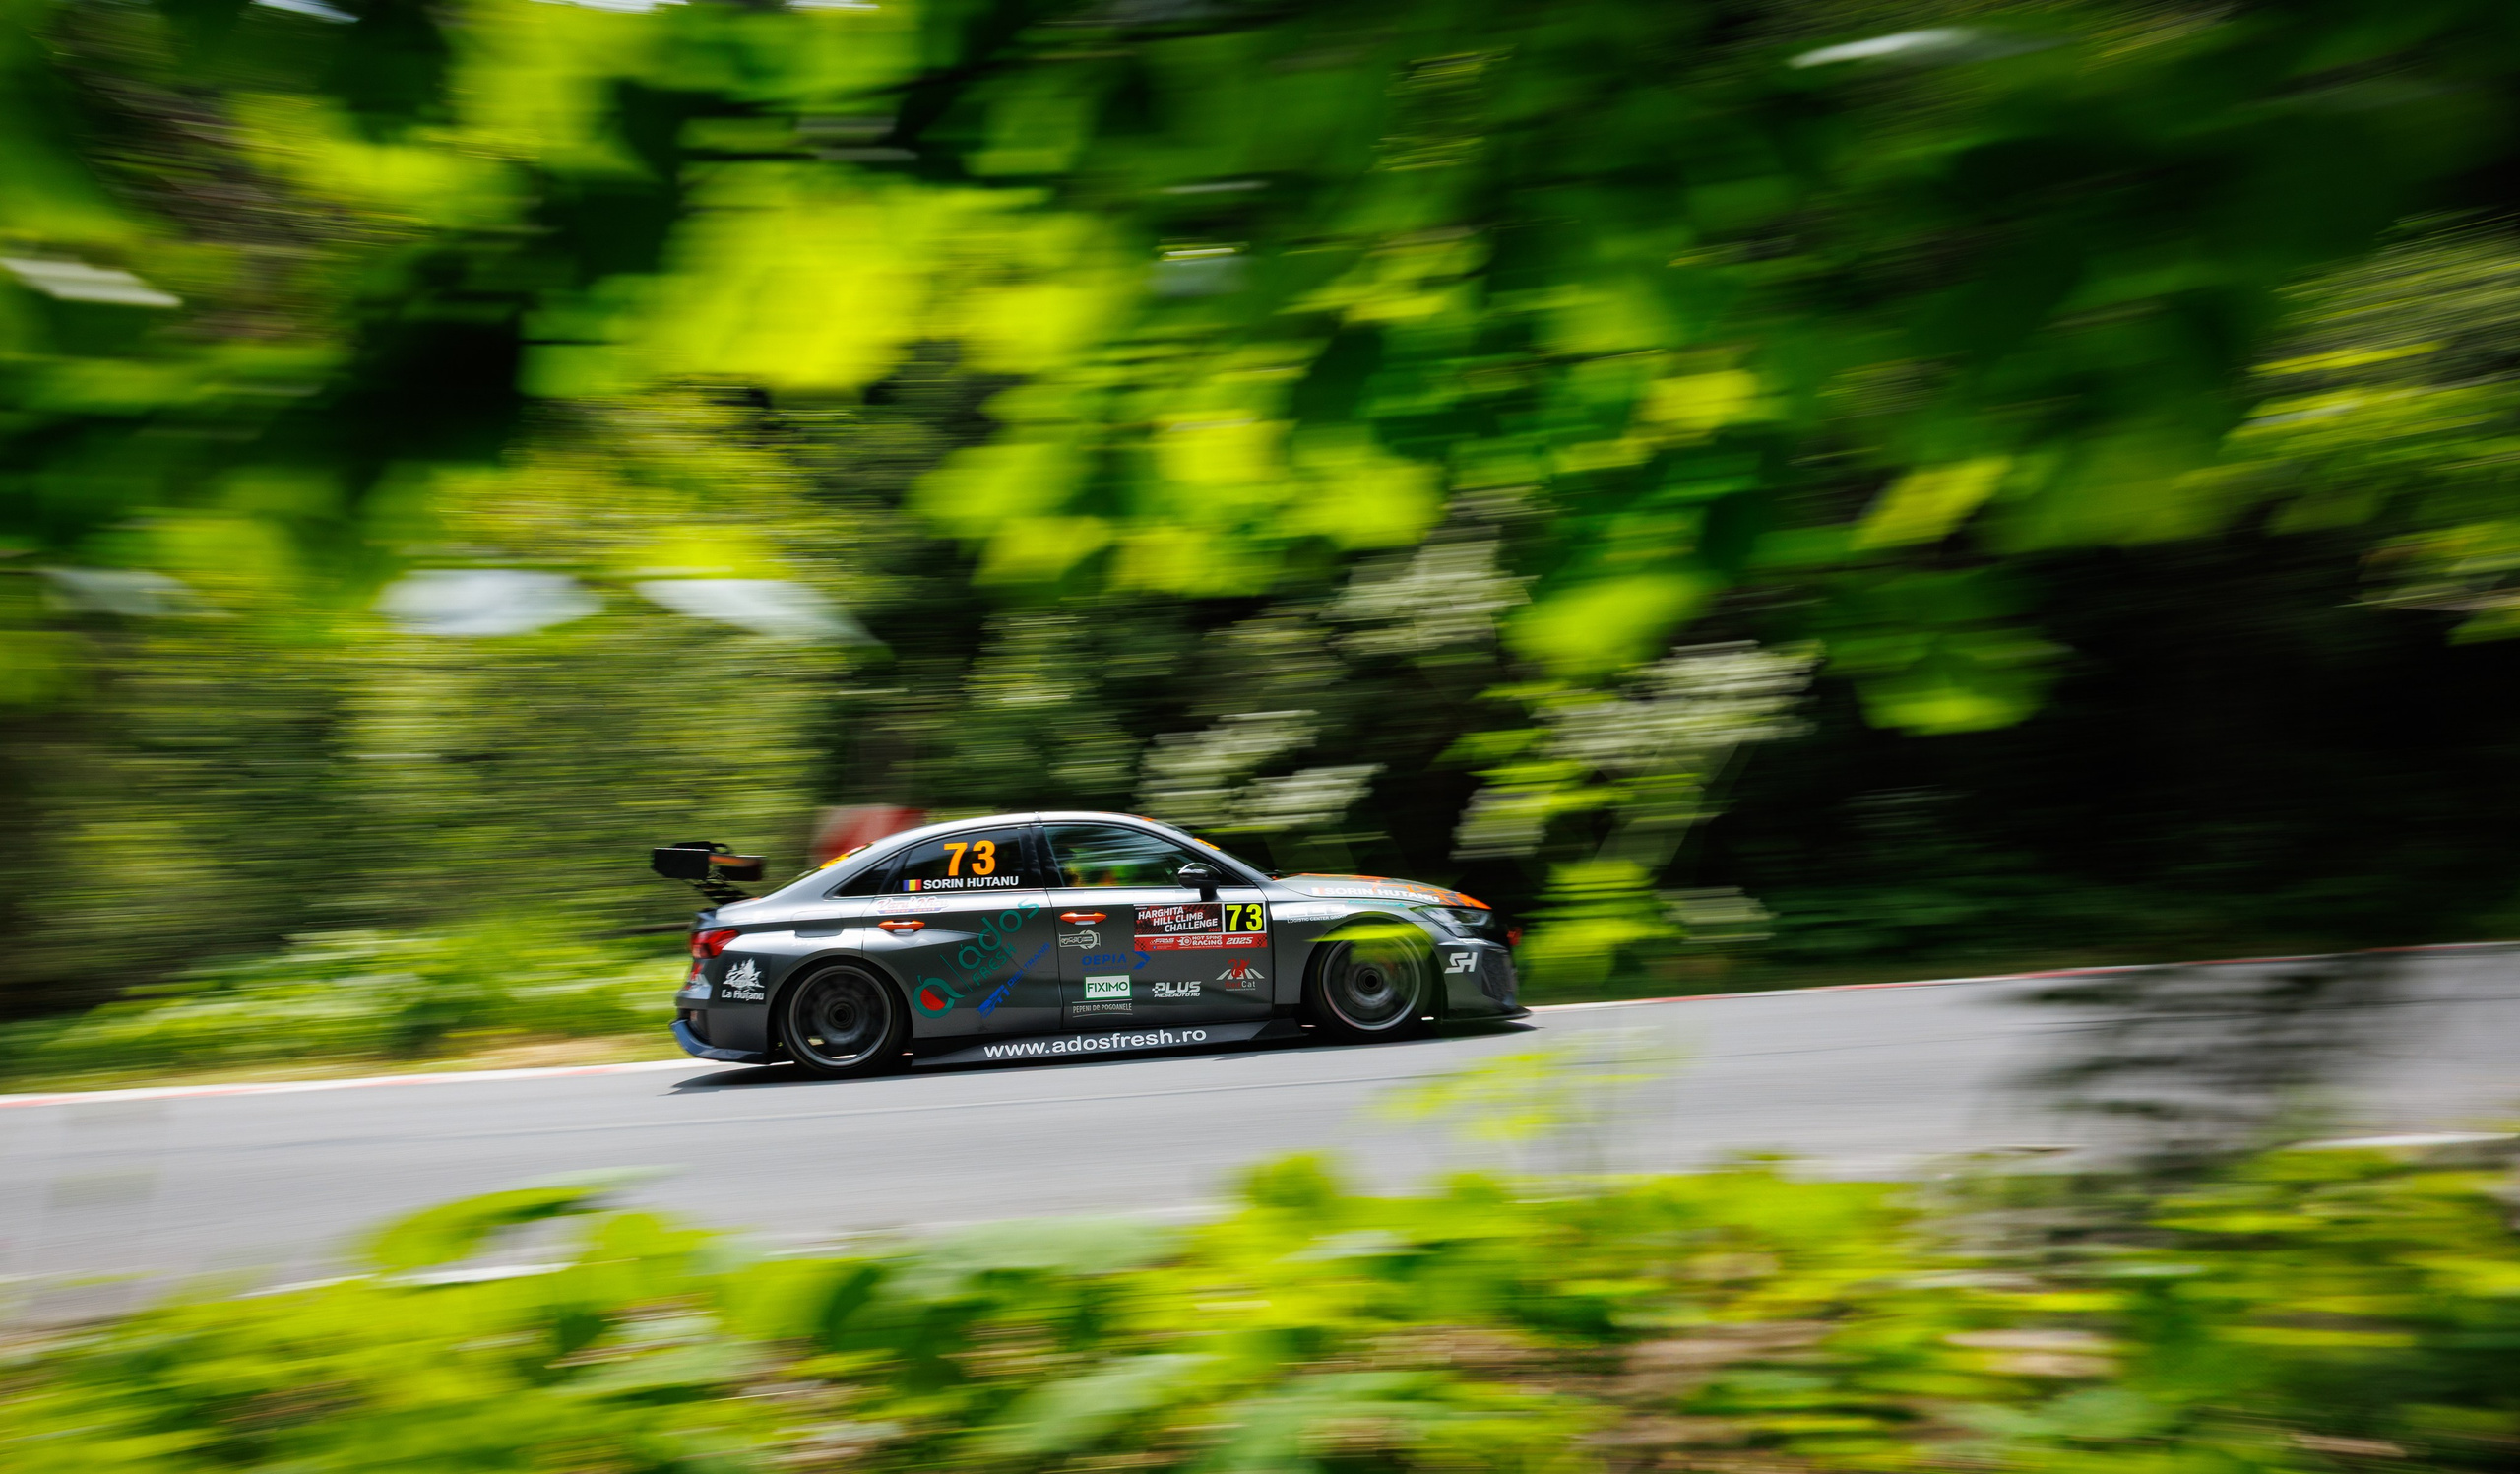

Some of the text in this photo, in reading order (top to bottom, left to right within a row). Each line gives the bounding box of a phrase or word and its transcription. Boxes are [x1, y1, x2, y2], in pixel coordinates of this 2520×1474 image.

[944, 840, 996, 876] 73
[923, 876, 1019, 890] SORIN HUTANU
[1324, 887, 1374, 896] SORIN
[1138, 906, 1184, 920] HARGHITA
[1153, 912, 1204, 927] HILL CLIMB
[1226, 904, 1263, 931] 73
[1165, 918, 1218, 932] CHALLENGE
[1226, 936, 1254, 945] 2025
[721, 989, 732, 998] La
[1087, 981, 1128, 993] FIXIMO
[1152, 981, 1201, 993] PLUS
[1073, 1004, 1092, 1013] PEPENI
[984, 1029, 1207, 1058] www.adosfresh.ro
